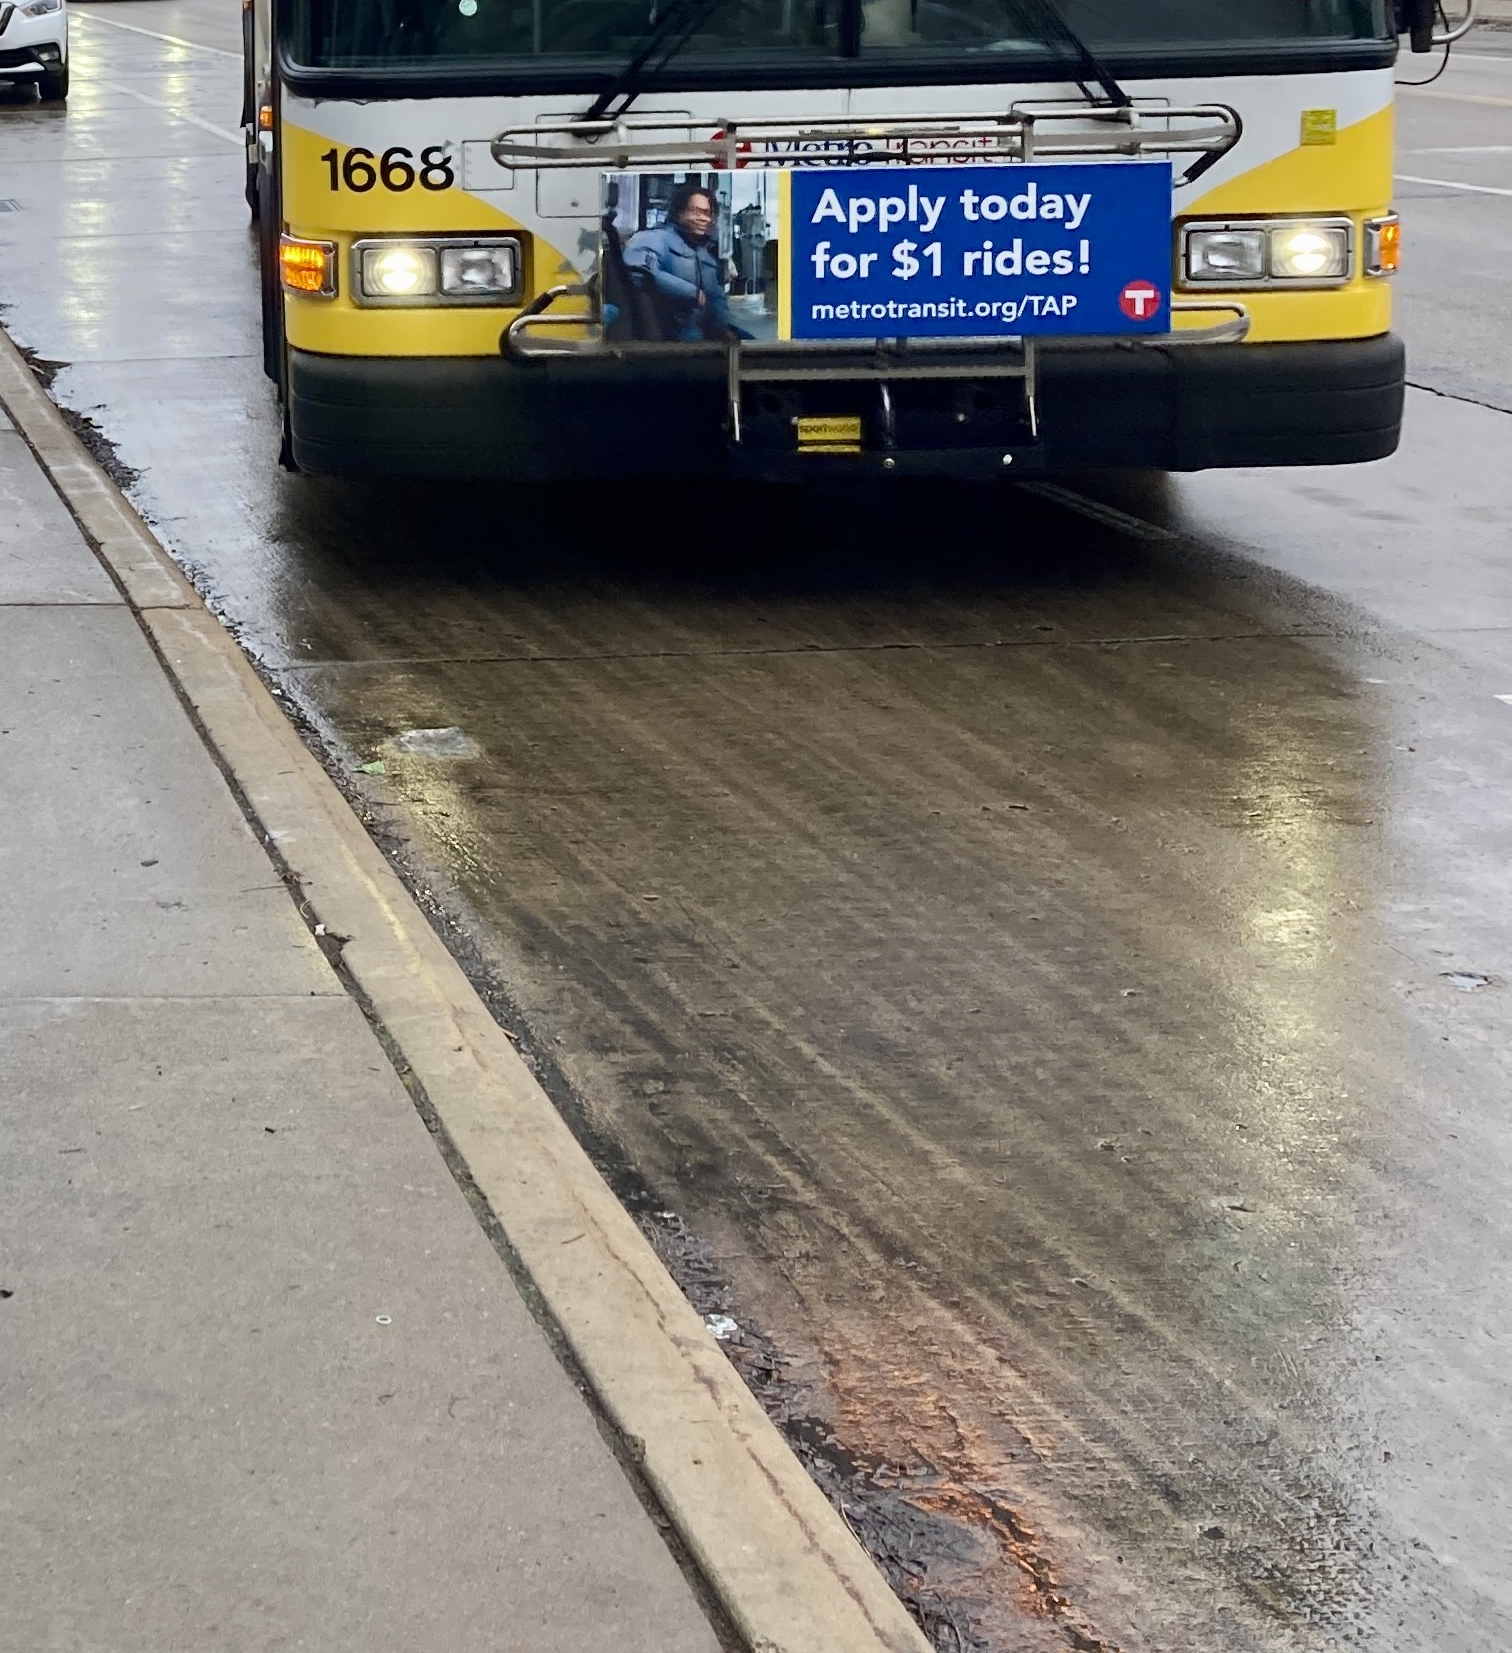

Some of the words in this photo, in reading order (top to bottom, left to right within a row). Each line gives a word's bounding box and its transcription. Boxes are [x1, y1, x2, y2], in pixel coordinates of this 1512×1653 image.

[320, 145, 455, 193] 1668
[810, 184, 947, 234] Apply
[959, 182, 1092, 230] today
[810, 240, 879, 279] for
[891, 238, 943, 281] $1
[963, 237, 1091, 277] rides!
[811, 294, 1078, 323] metrotransit.org/TAP
